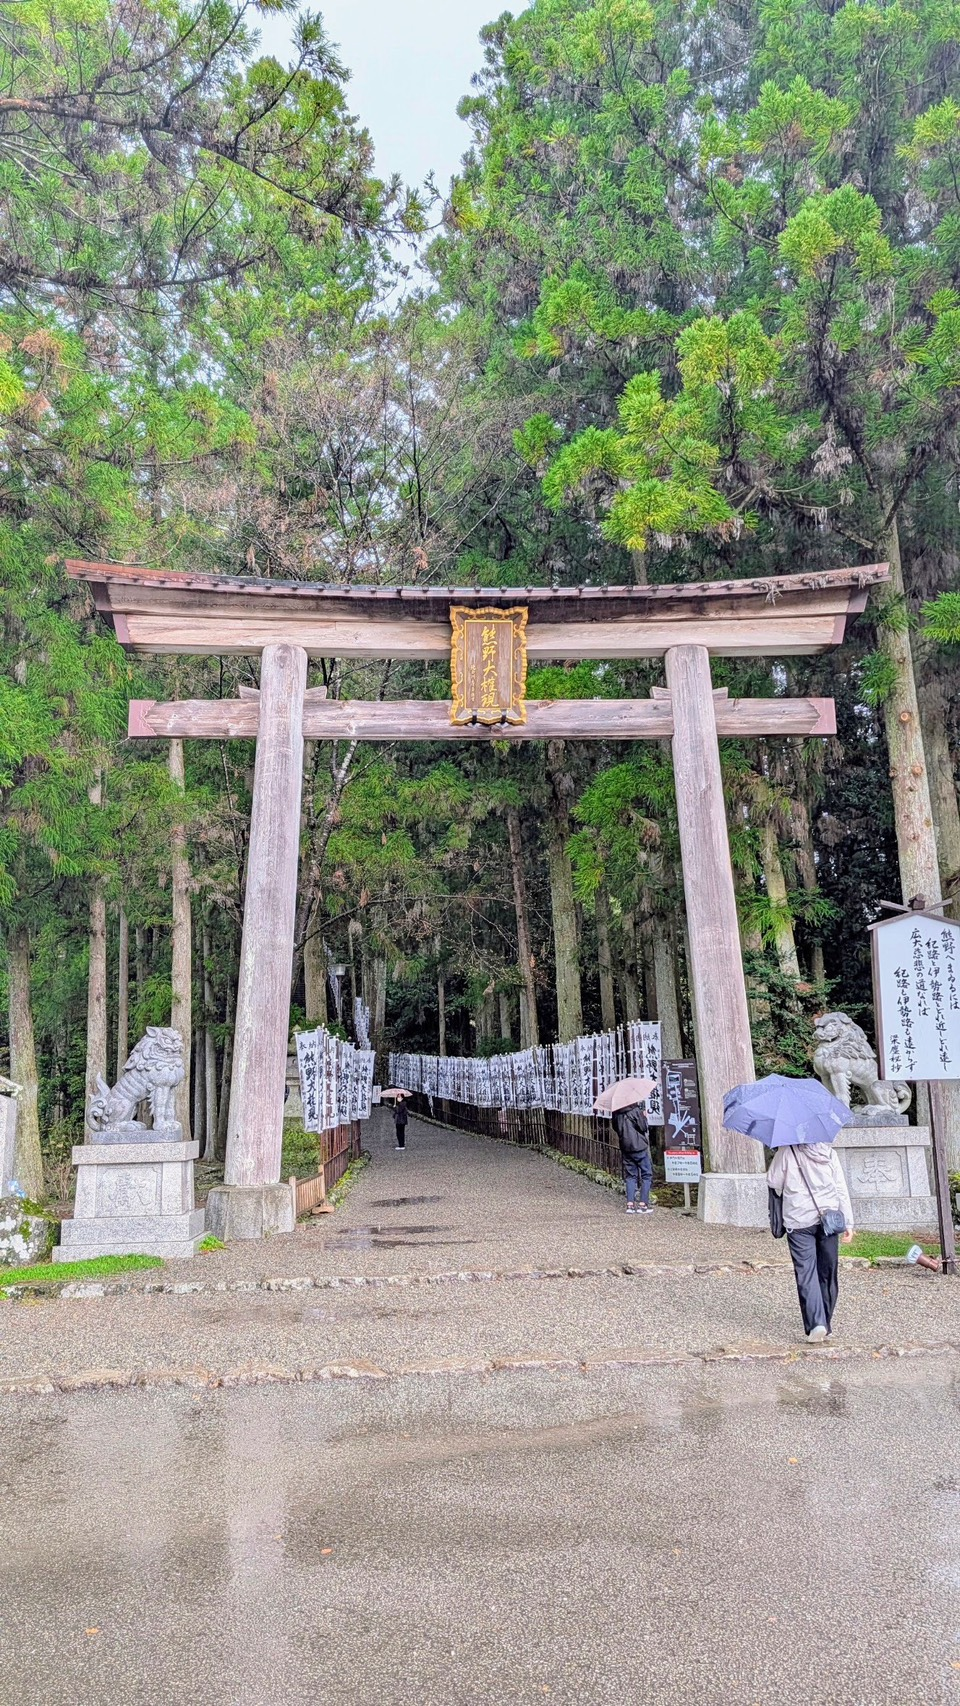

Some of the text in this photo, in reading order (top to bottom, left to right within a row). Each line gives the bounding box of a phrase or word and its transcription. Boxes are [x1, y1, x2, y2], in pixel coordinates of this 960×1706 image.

[481, 624, 499, 708] 熊野大権現
[910, 927, 930, 1017] 広大慈悲の道なれば
[941, 928, 960, 1010] 熊野へまゐるには
[893, 966, 918, 1073] 紀路も伊勢路も遠からず
